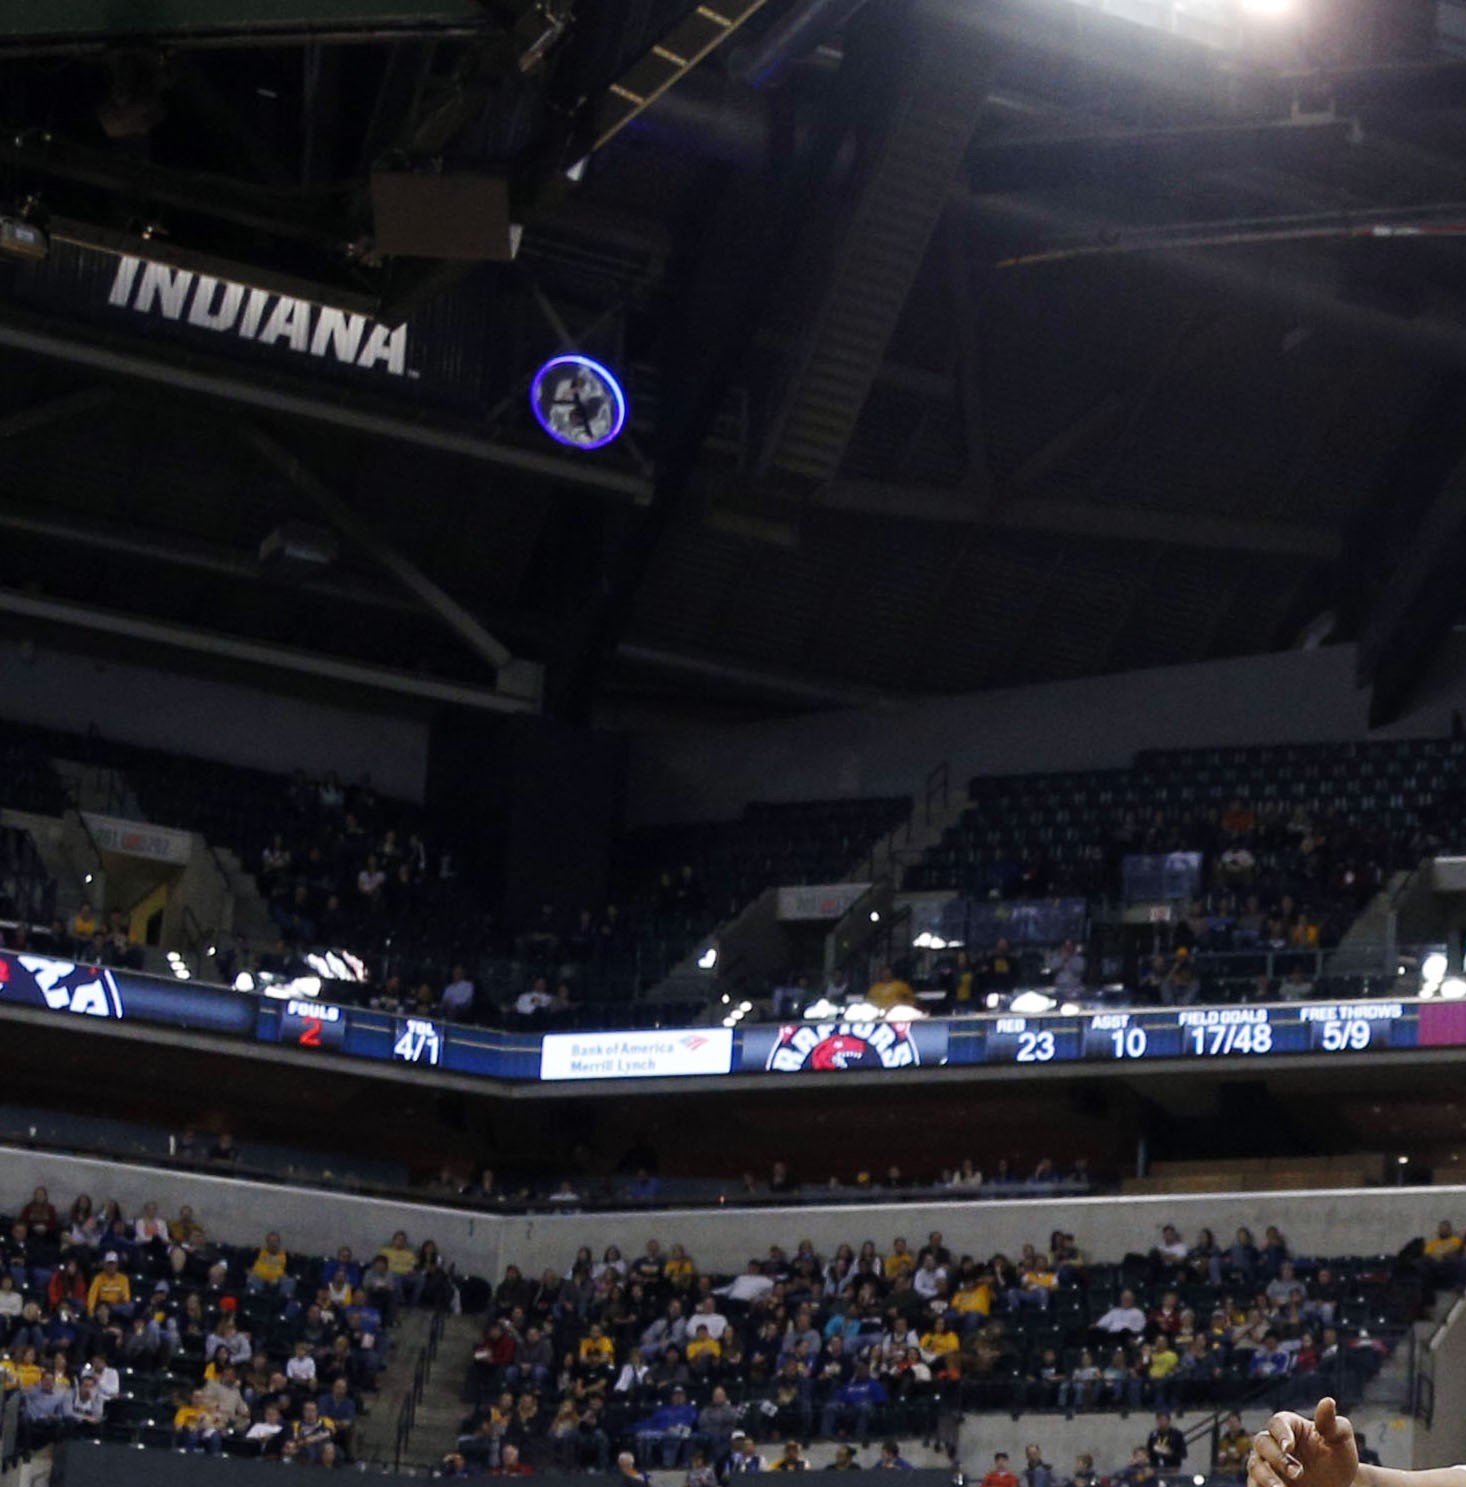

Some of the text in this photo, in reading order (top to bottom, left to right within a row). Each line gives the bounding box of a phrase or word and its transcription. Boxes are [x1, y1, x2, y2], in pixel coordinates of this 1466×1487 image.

[108, 255, 407, 376] INDIANA
[299, 1015, 322, 1046] 2
[1111, 1027, 1147, 1058] 10
[1191, 1023, 1272, 1055] 17/48
[1322, 1019, 1371, 1051] 5/9
[394, 1032, 439, 1065] 4/1
[571, 1041, 675, 1057] Bank of America
[1017, 1031, 1055, 1062] 23
[571, 1058, 656, 1074] Merrill Lynch
